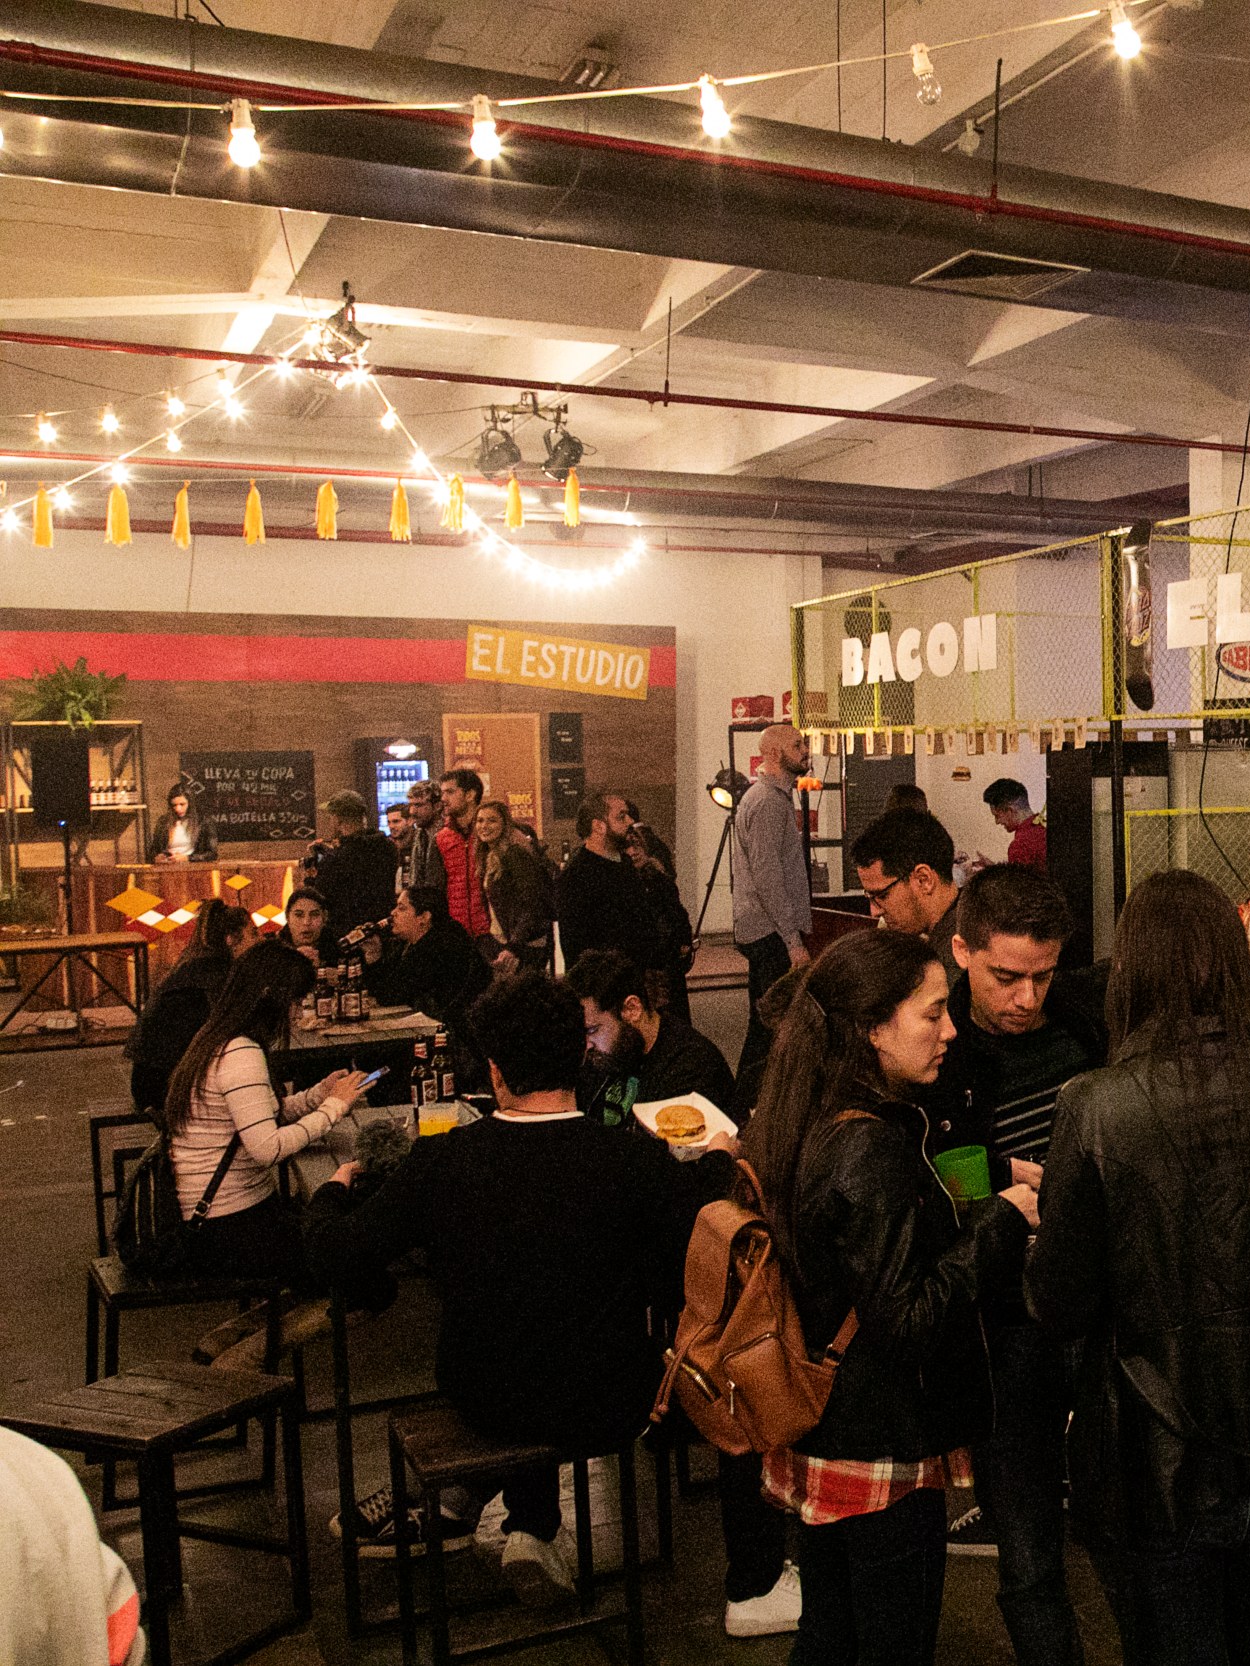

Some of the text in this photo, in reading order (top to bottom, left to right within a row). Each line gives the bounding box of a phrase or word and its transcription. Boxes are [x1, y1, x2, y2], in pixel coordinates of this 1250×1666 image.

[471, 633, 645, 690] EL ESTUDIO
[841, 613, 997, 686] BACON
[204, 767, 241, 780] LLEVA
[262, 766, 294, 780] COPA
